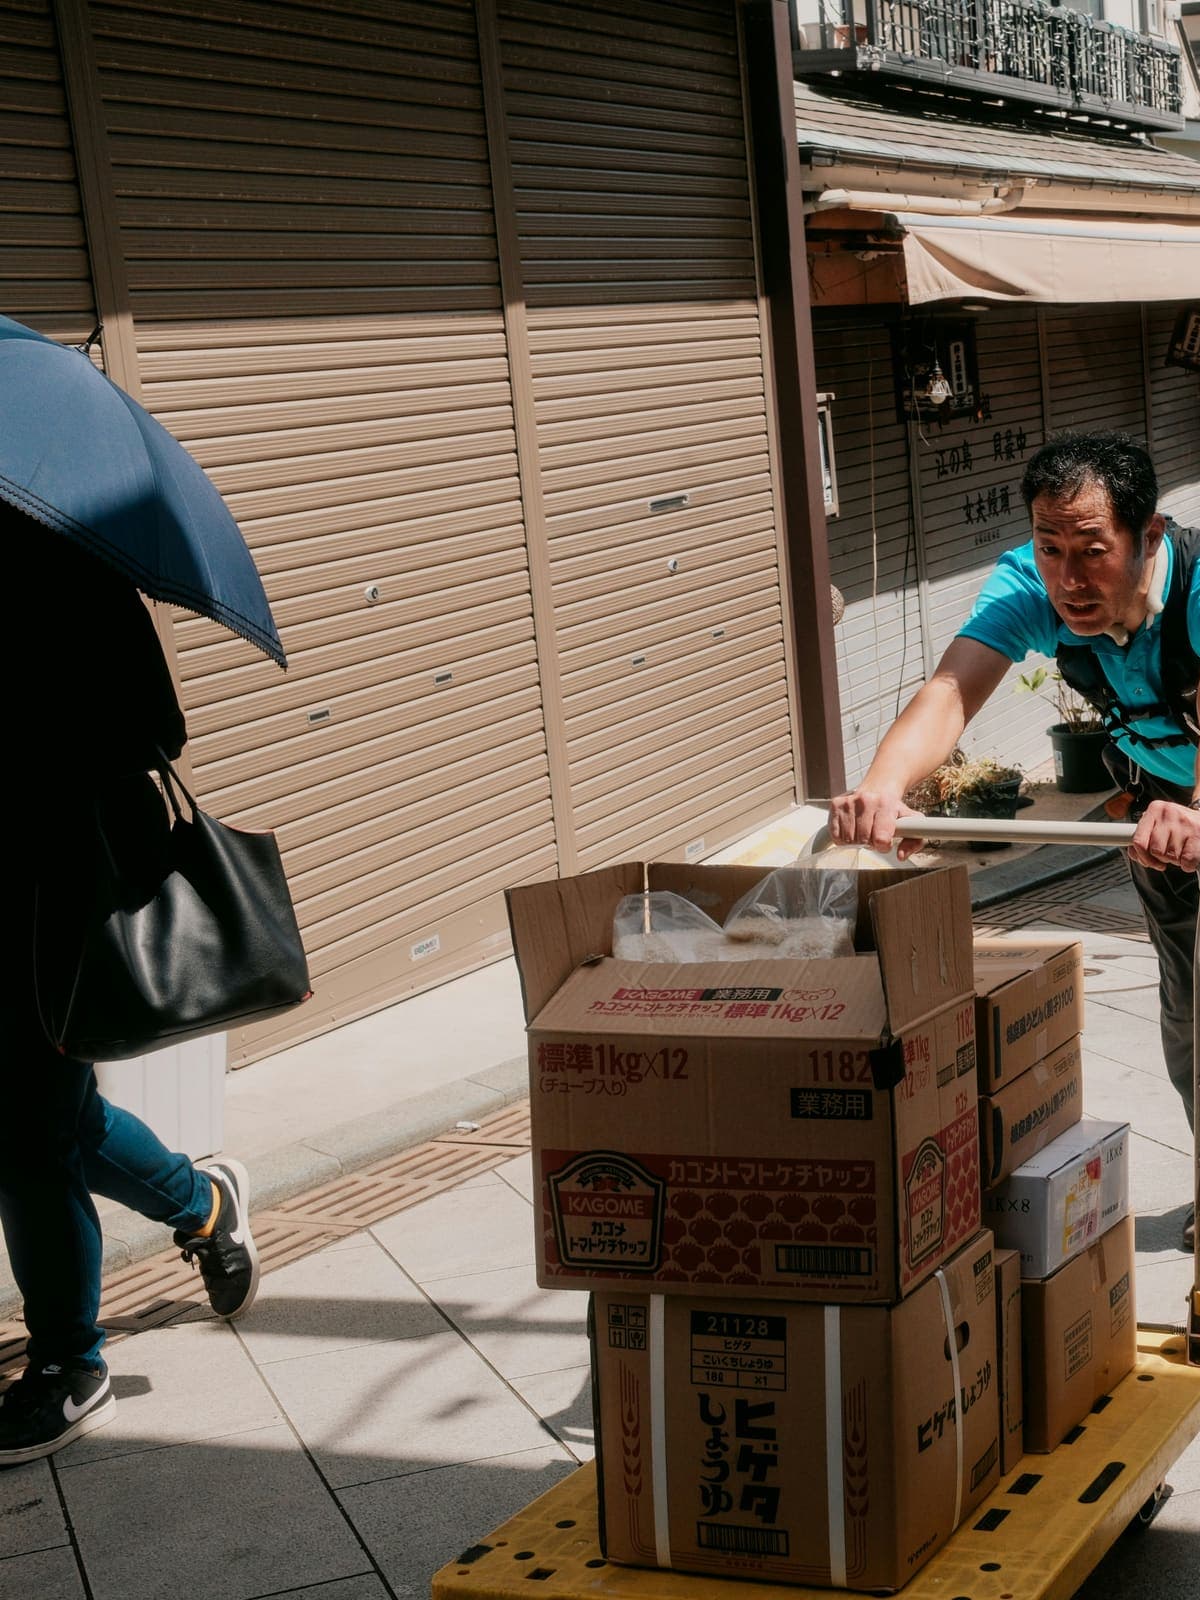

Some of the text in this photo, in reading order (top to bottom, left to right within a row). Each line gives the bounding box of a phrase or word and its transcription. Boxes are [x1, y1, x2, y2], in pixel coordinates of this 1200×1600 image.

[621, 990, 698, 1000] KAGOME
[711, 989, 772, 1000] 業務用
[957, 1006, 974, 1043] 1182
[808, 1048, 871, 1084] 1182
[539, 1077, 628, 1097] (チューブ入り)
[798, 1093, 867, 1118] 業務用
[568, 1195, 645, 1216] KAGOME
[591, 1221, 627, 1237] カゴメ
[707, 1315, 769, 1337] 21128
[723, 1339, 752, 1351] ヒゲタ
[702, 1355, 774, 1370] こいくちしょうゆ
[697, 1392, 734, 1518] しょうゆ
[734, 1398, 782, 1525] ヒゲタ
